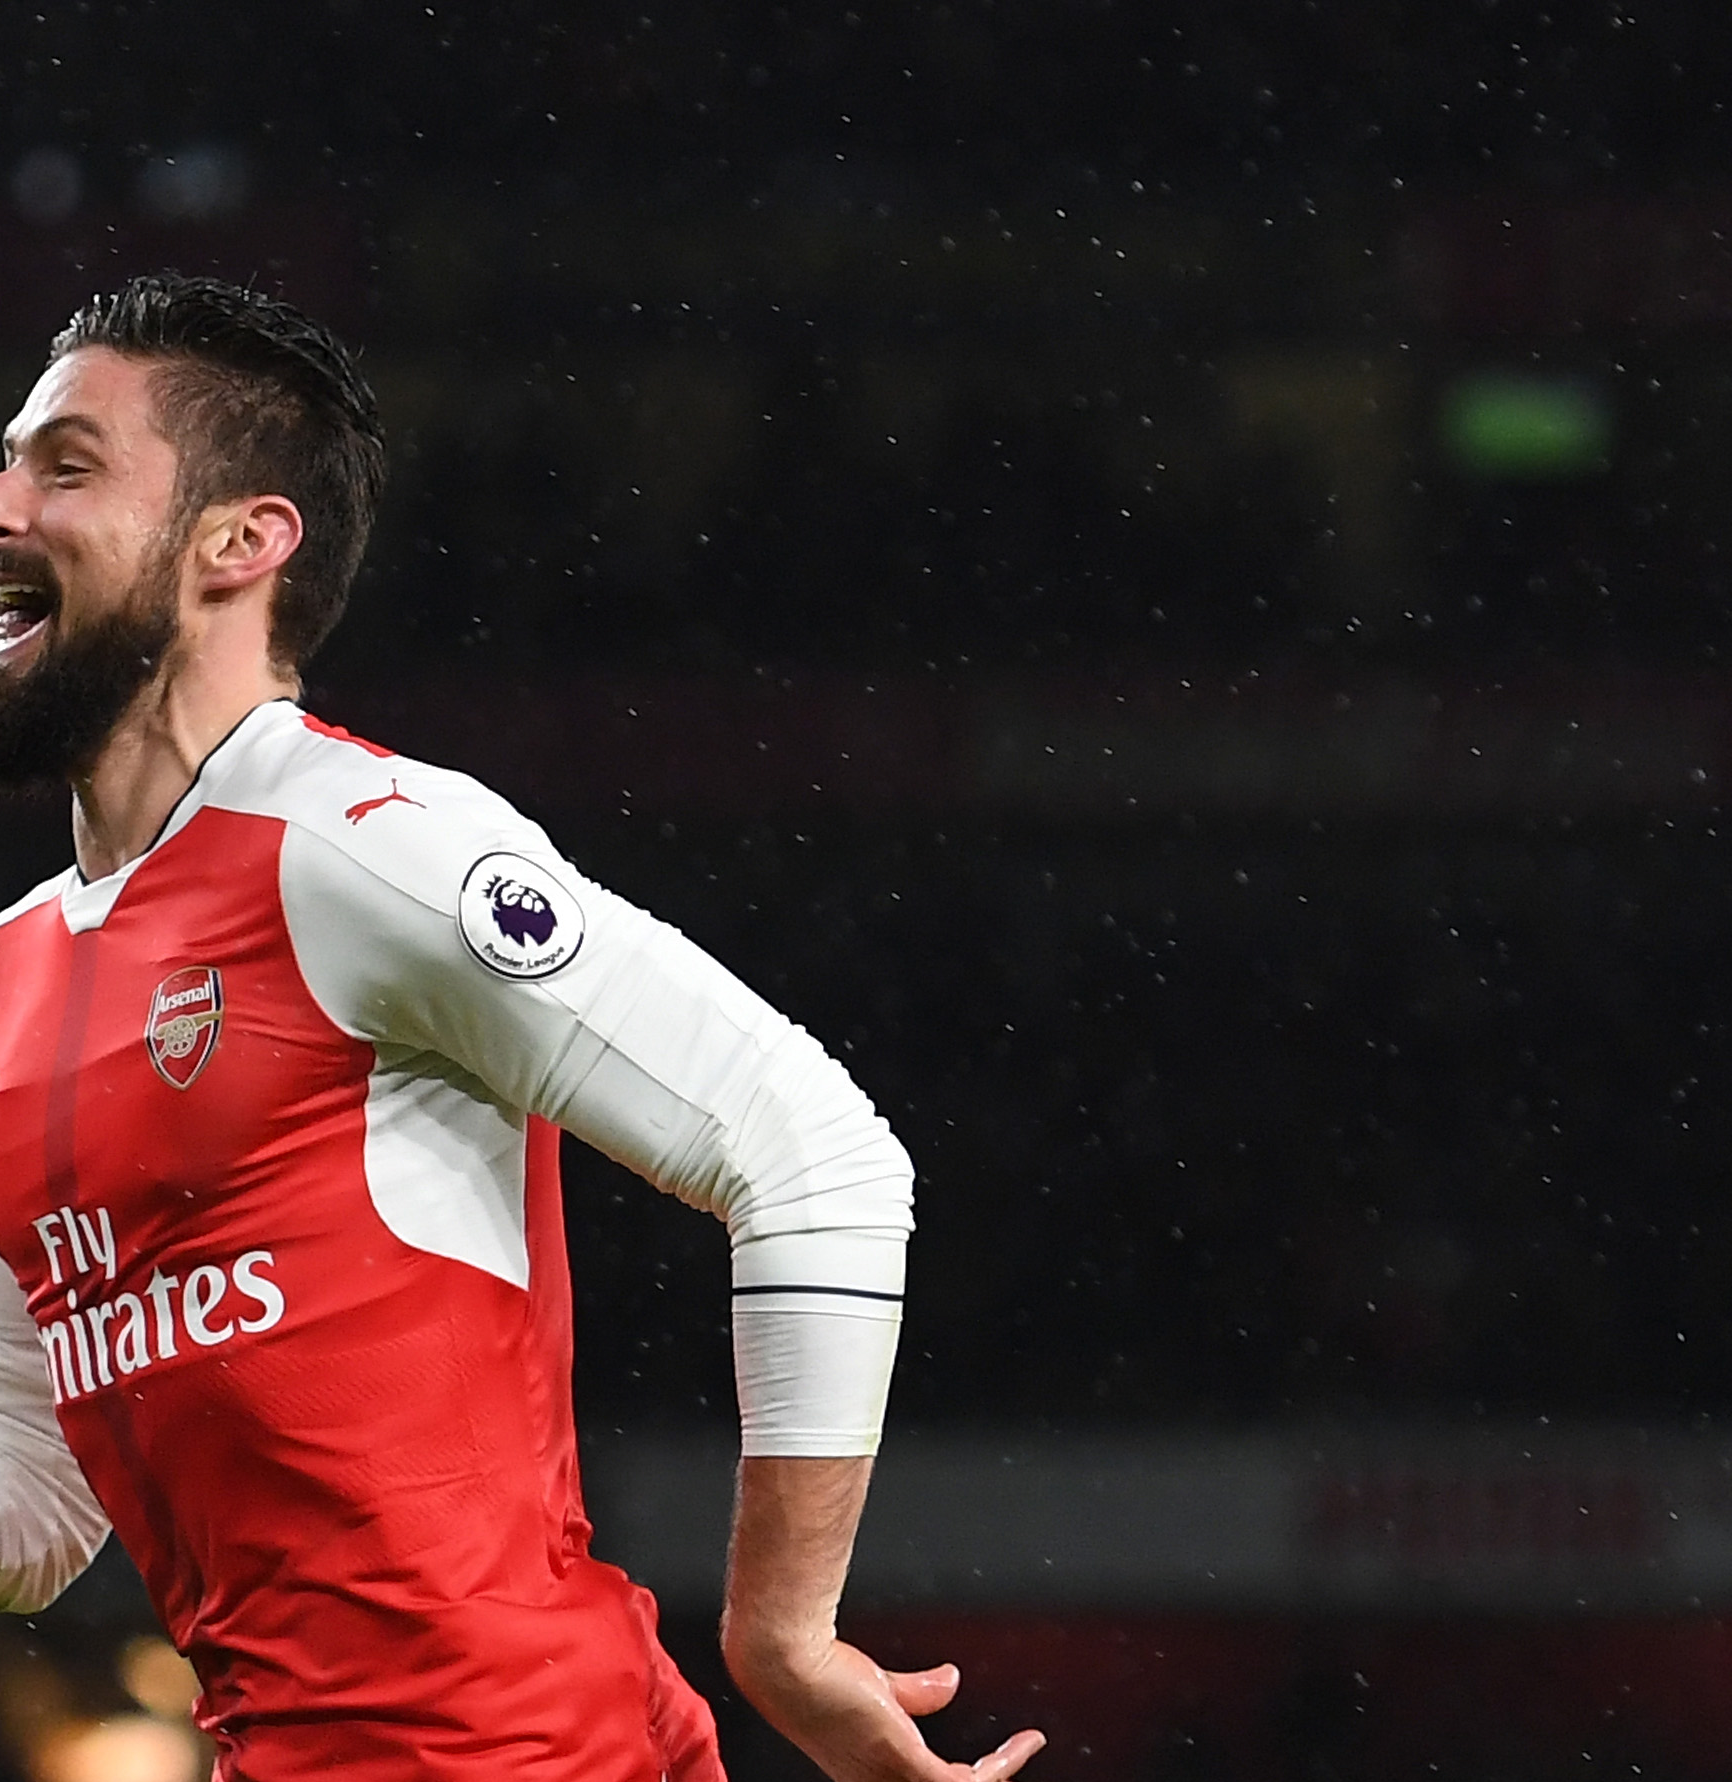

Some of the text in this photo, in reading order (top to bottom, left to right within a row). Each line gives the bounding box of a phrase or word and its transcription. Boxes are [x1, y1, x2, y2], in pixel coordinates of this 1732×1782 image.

[481, 942, 565, 969] Premier League
[157, 981, 211, 1014] Arsenal
[31, 1206, 117, 1285] Fly
[37, 1250, 285, 1405] mirates
